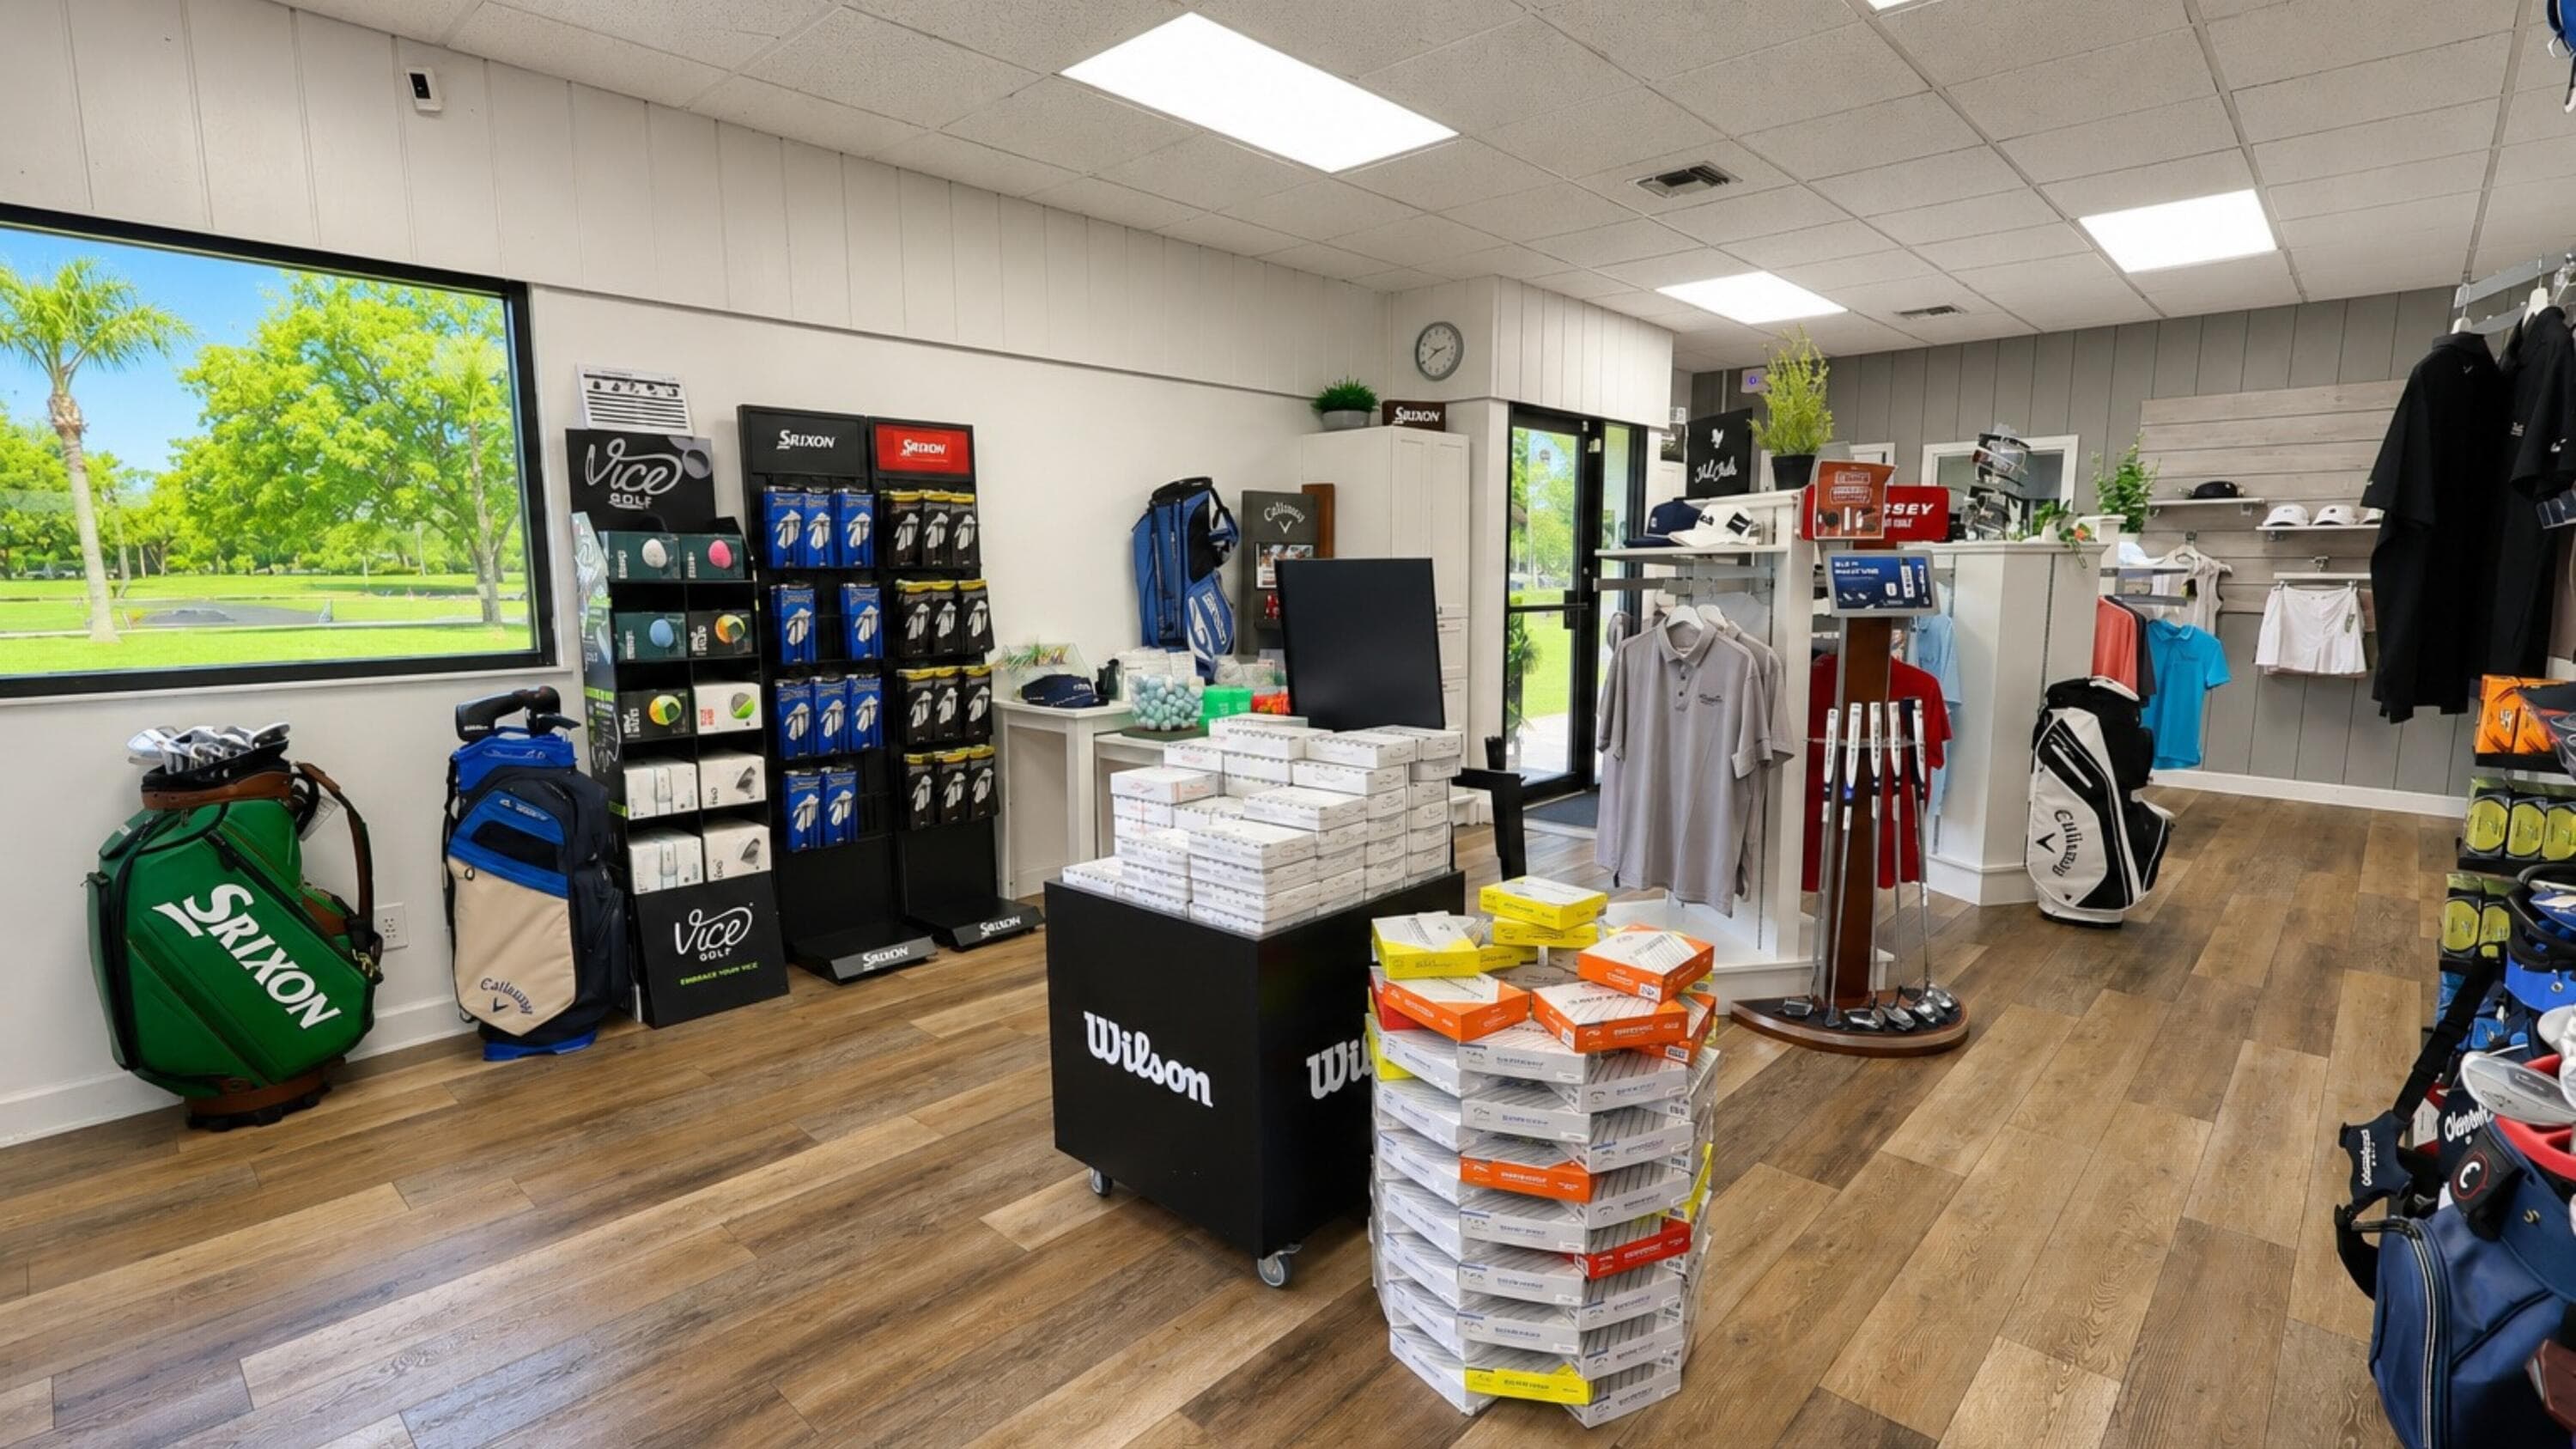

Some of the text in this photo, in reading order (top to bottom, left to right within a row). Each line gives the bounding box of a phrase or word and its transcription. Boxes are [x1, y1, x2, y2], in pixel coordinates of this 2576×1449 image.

[776, 429, 835, 449] SRIXON
[585, 437, 683, 496] Vice
[608, 493, 653, 509] GOLF
[153, 884, 342, 1030] SRIXON
[674, 909, 753, 955] Vice
[699, 947, 732, 962] GOLF
[1084, 1010, 1213, 1108] Wilson
[1306, 1032, 1373, 1099] Wil
